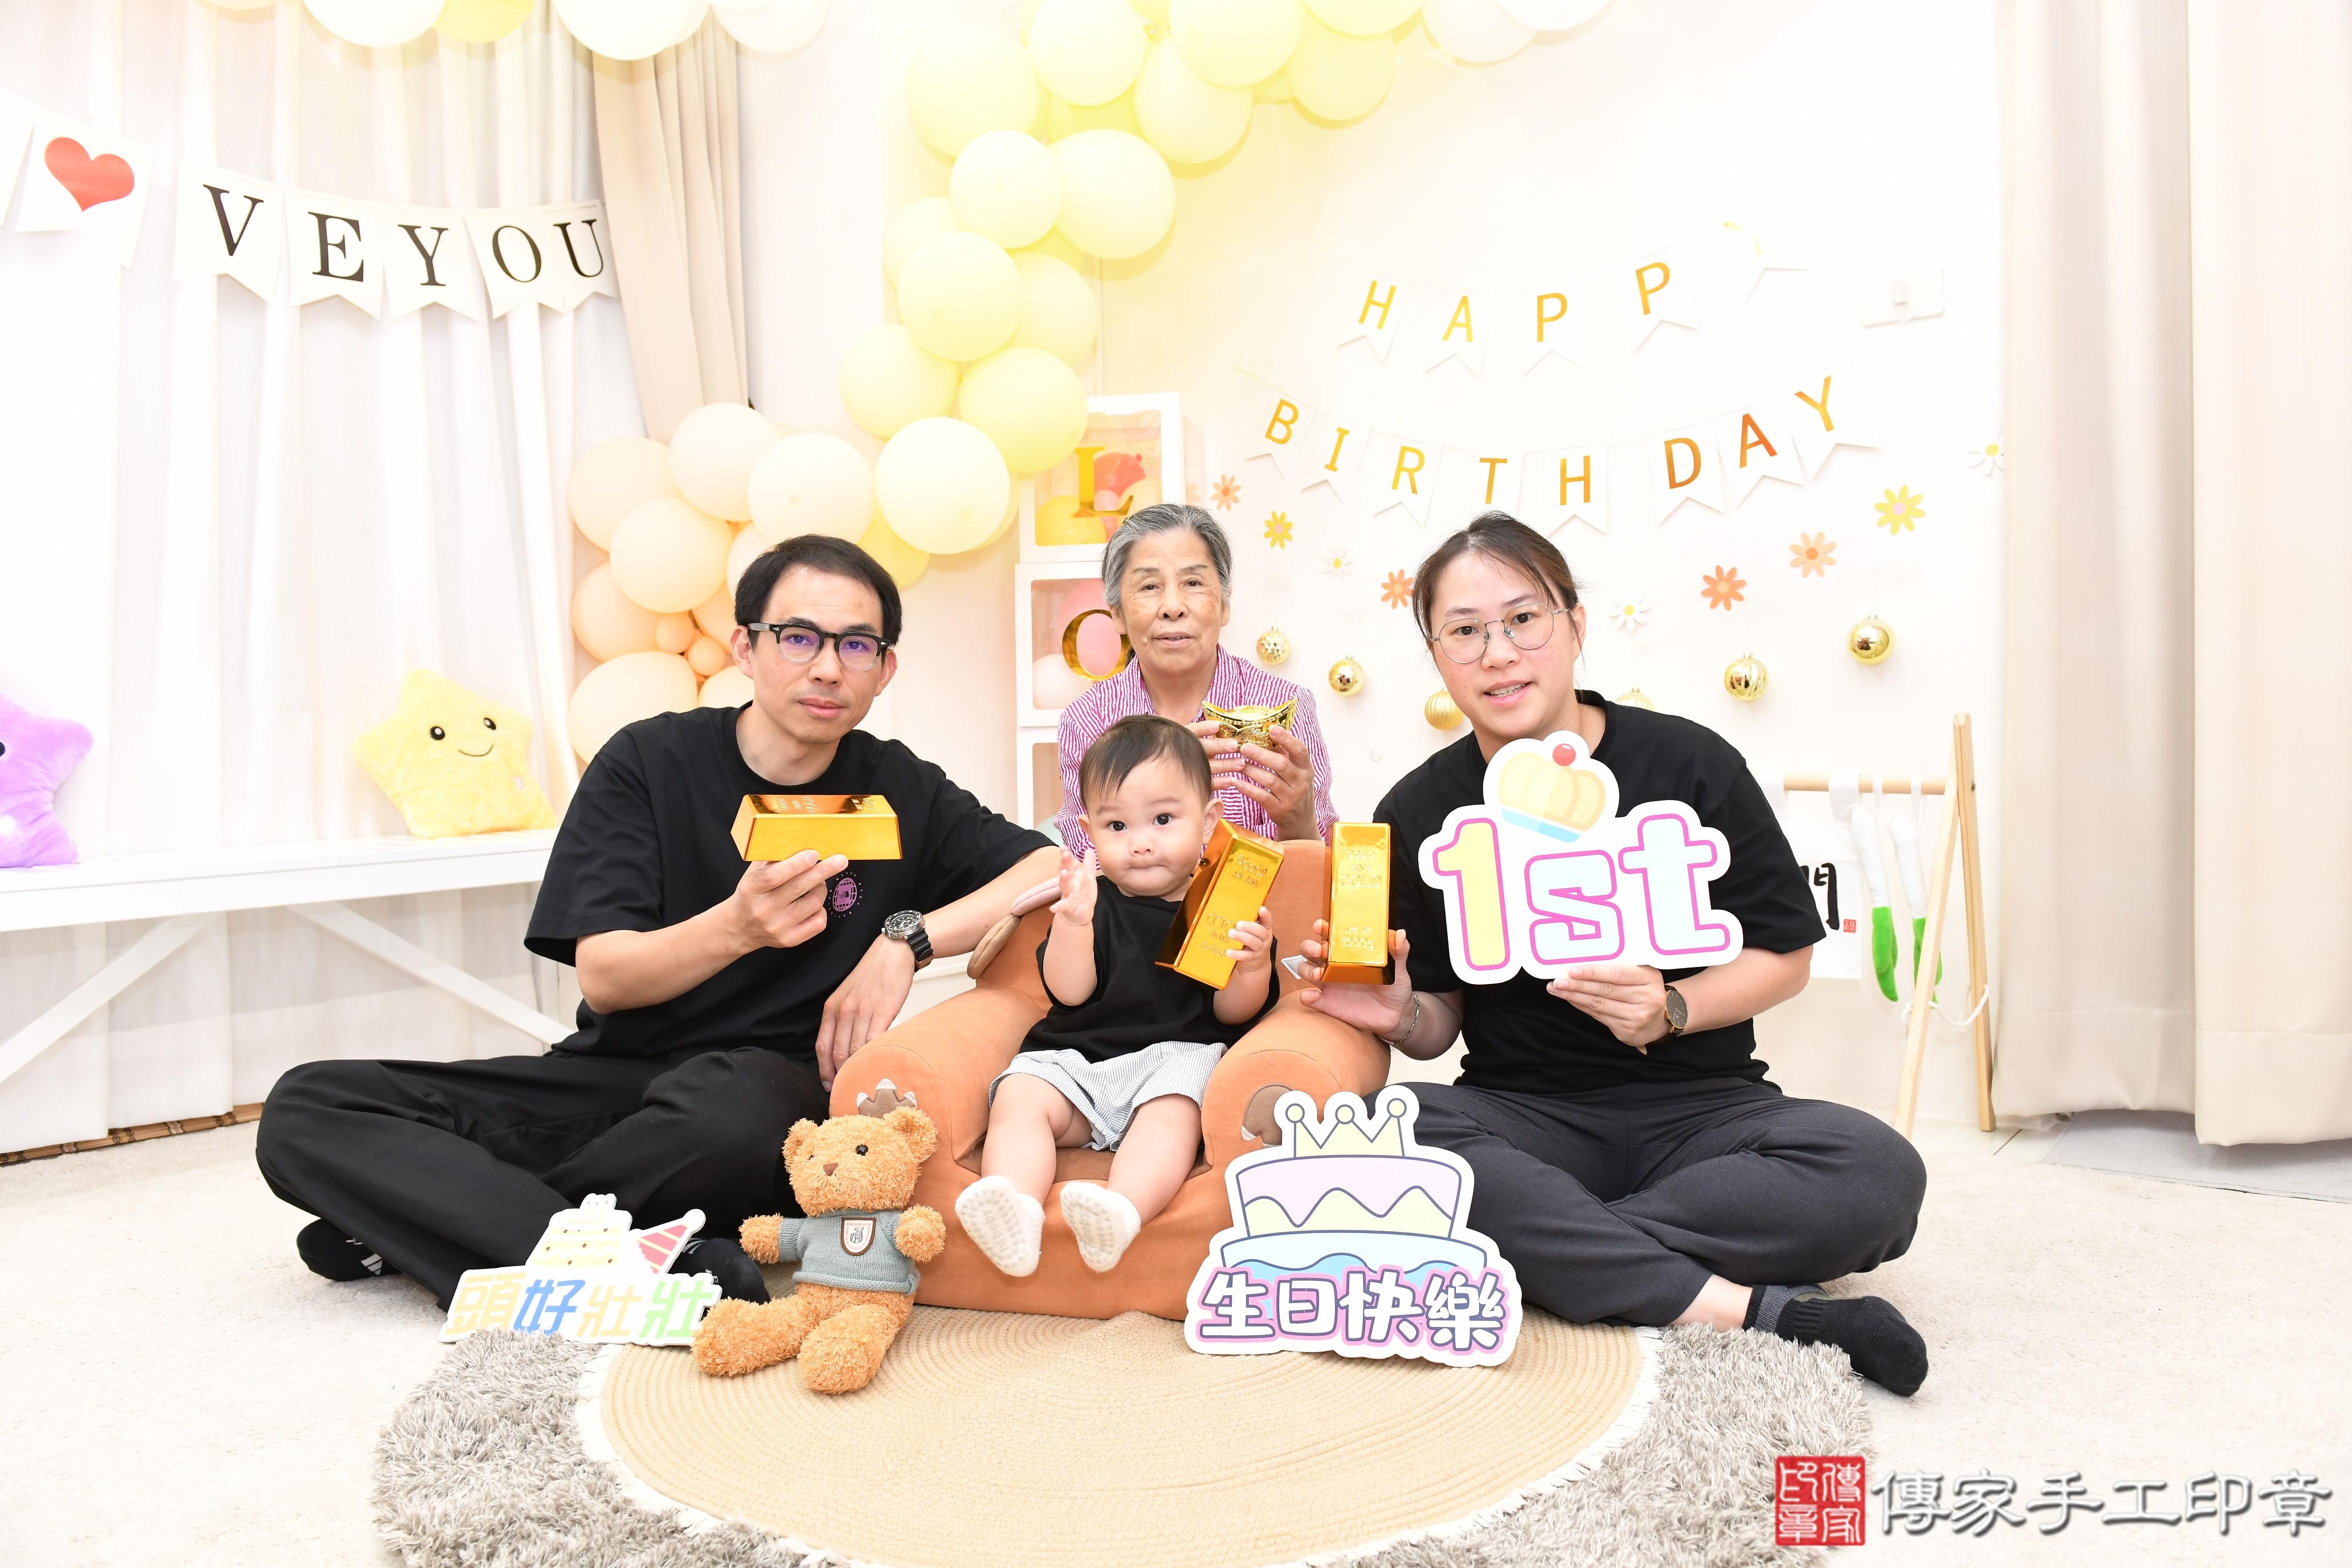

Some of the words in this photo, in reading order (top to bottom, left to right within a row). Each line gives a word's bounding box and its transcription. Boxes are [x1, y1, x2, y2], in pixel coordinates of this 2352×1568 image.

[1265, 398, 1591, 505] BIRTH
[1664, 376, 1834, 489] DAY
[1340, 874, 1382, 888] GOLD
[1431, 812, 1732, 971] 1st
[1198, 1268, 1506, 1353] 生日快樂
